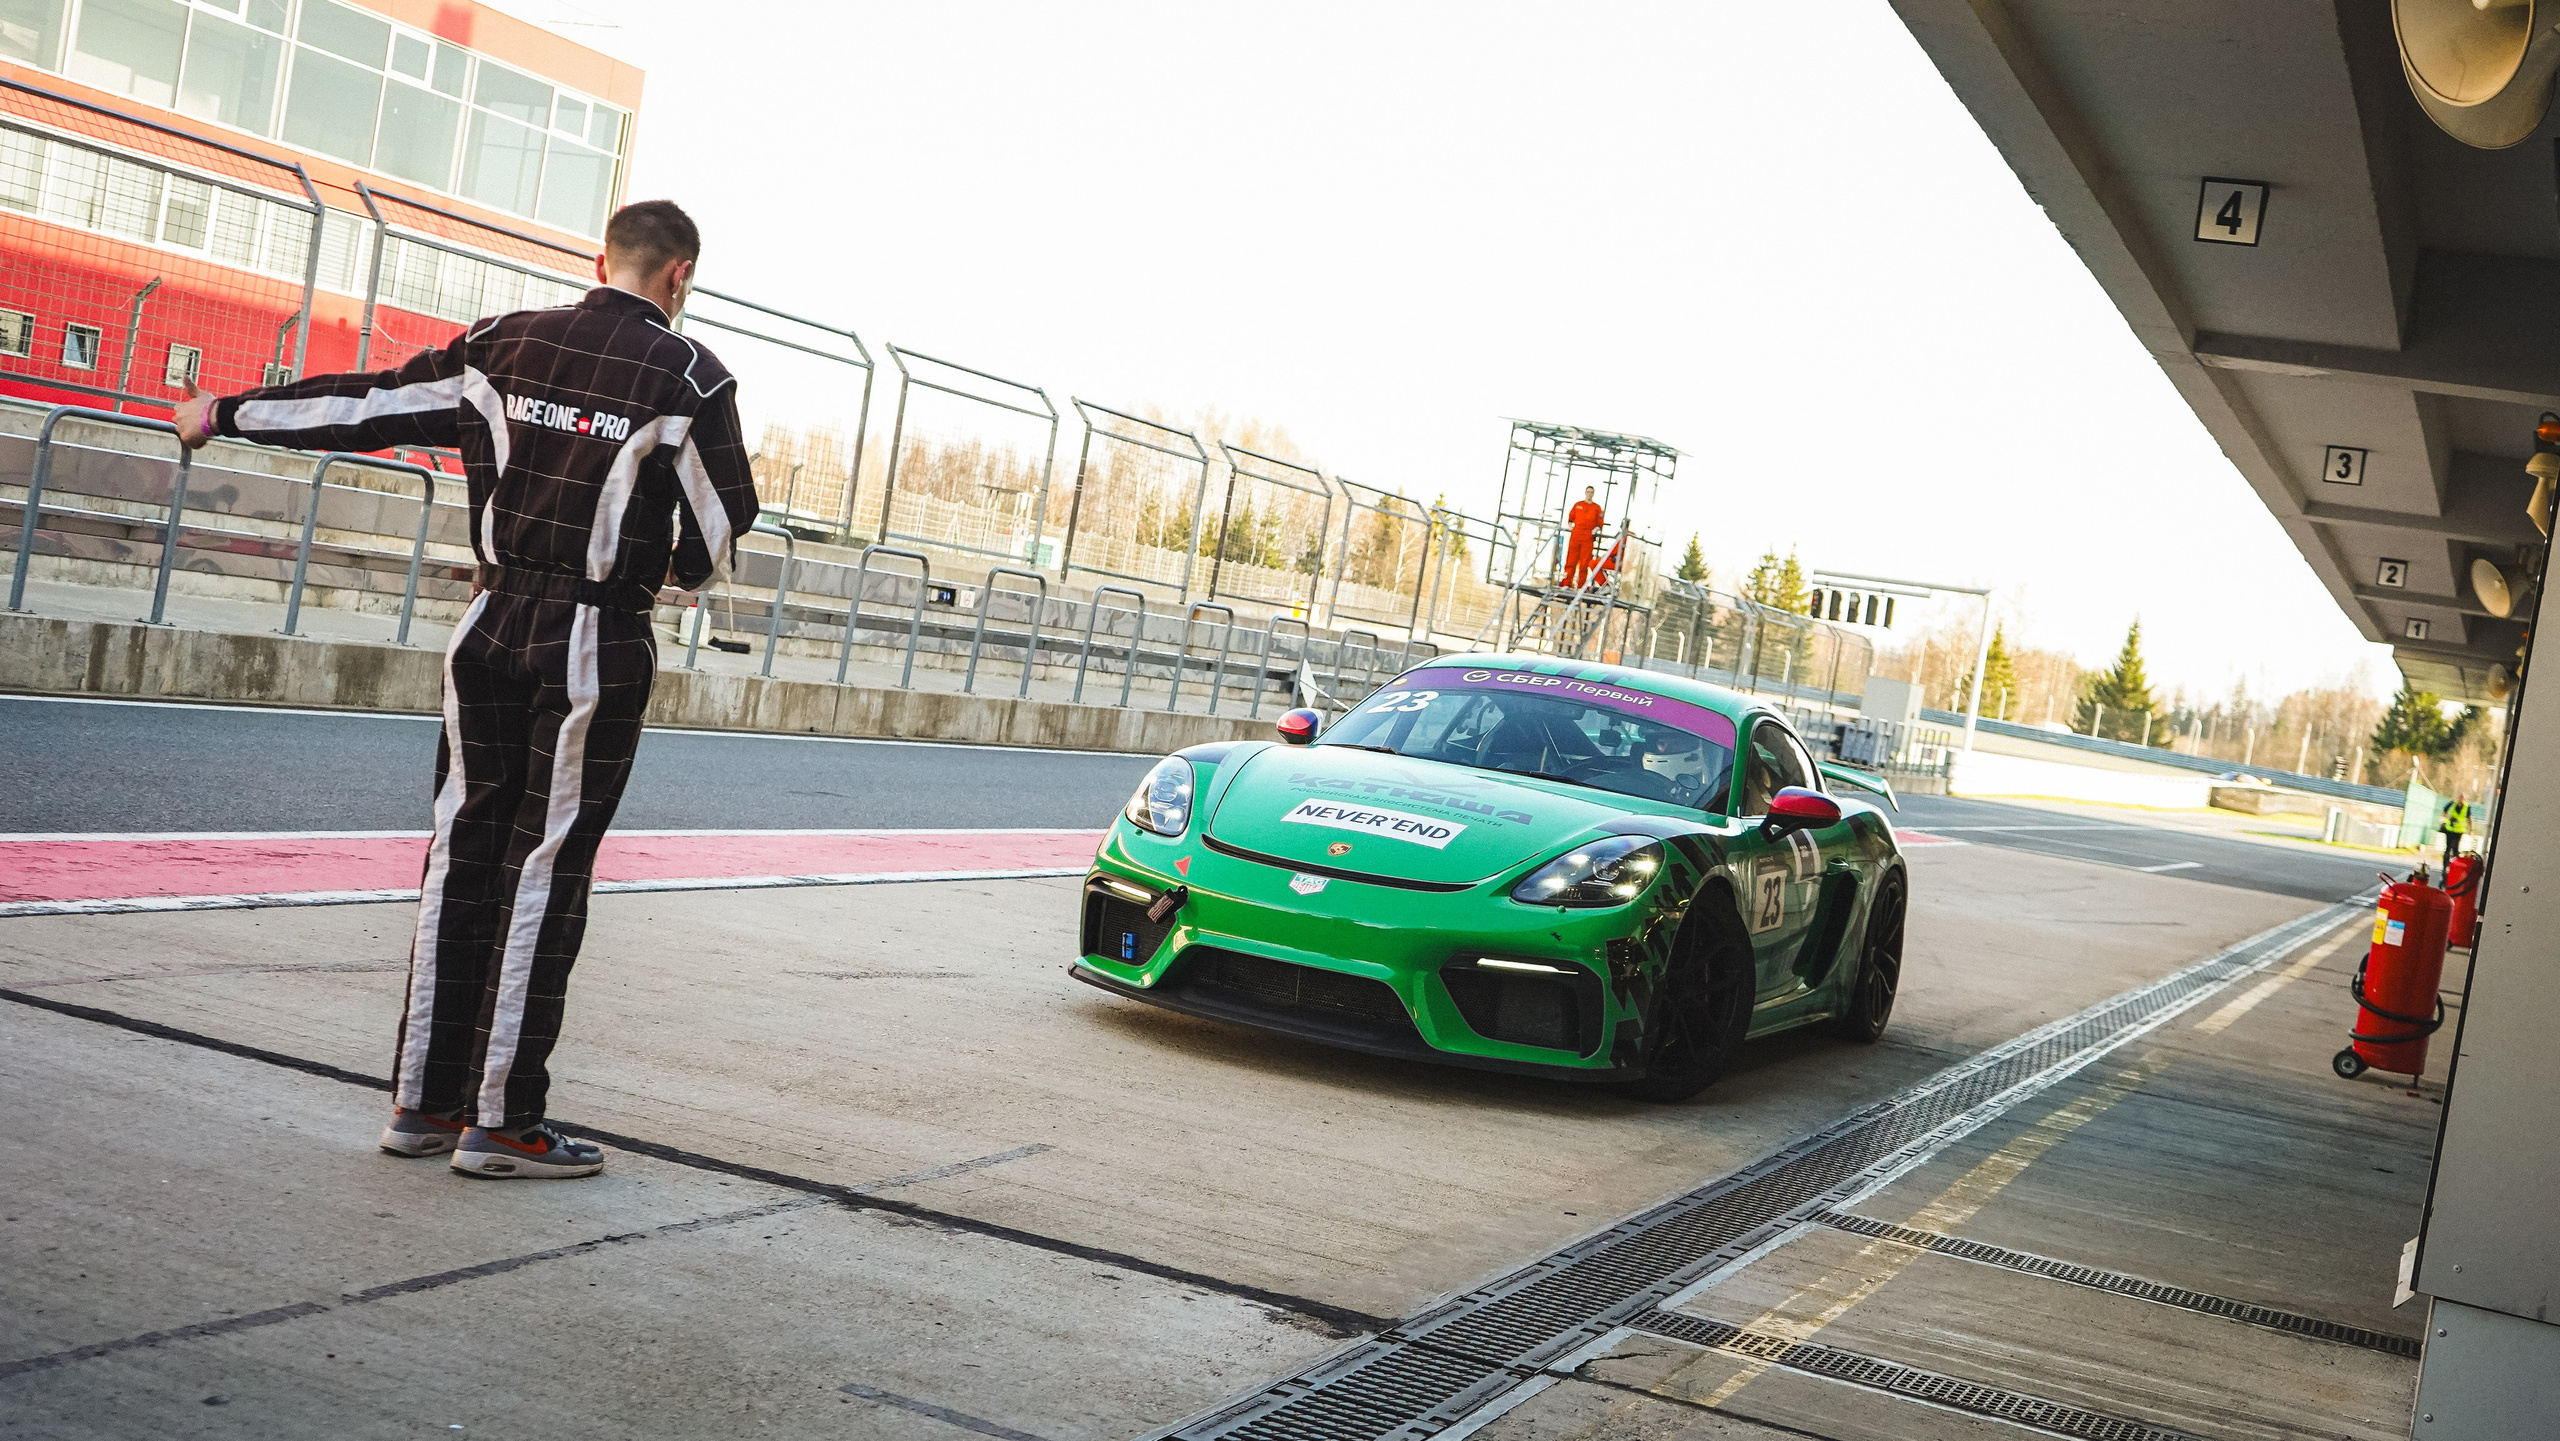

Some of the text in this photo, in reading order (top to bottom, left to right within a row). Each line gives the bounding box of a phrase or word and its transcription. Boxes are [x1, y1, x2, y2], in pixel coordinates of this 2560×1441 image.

[2216, 190, 2243, 235] 4
[589, 411, 631, 441] PRO
[2336, 452, 2352, 479] 3
[2385, 565, 2398, 584] 2
[2413, 623, 2422, 636] 1
[1366, 690, 1439, 714] 23
[1495, 673, 1654, 708] СБЕР Первый
[1371, 797, 1450, 816] ЭКОСИСТЕМА
[1453, 812, 1503, 828] ПЕЧАТИ
[1760, 875, 1782, 928] 23
